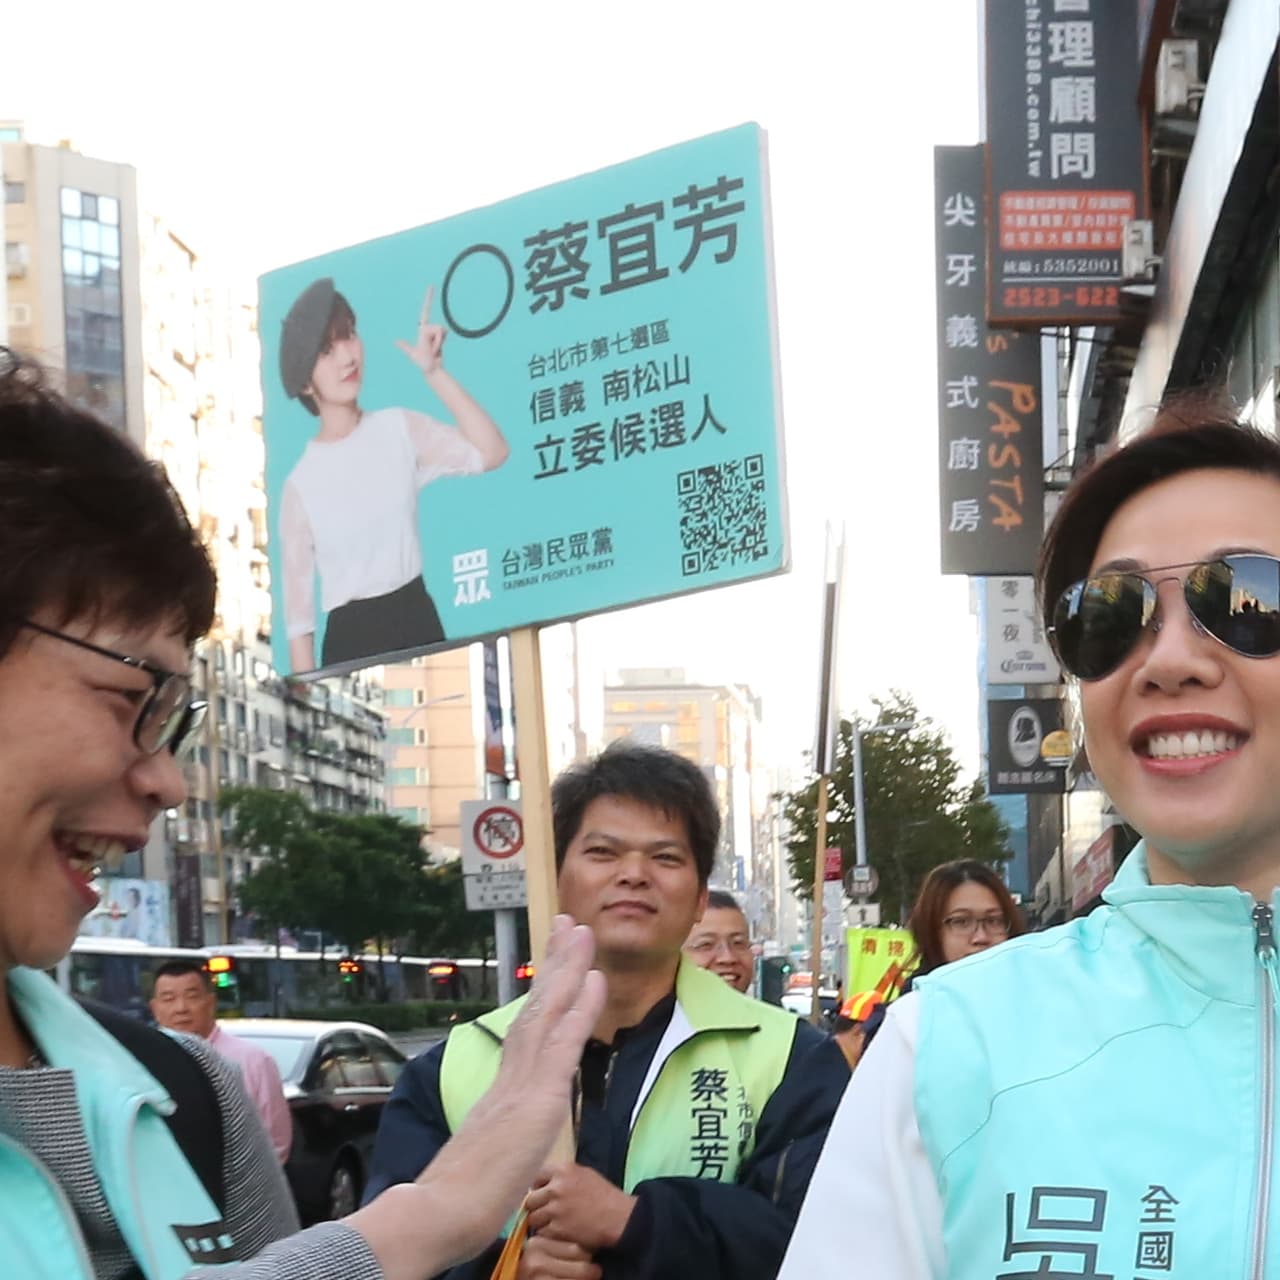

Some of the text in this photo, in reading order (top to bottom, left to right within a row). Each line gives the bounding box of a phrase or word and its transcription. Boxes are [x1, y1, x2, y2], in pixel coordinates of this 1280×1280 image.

[523, 176, 745, 315] 蔡宜芳
[527, 319, 670, 380] 台北市第七選區
[529, 353, 691, 424] 信義 南松山
[944, 192, 981, 533] 尖牙義式廚房
[533, 394, 727, 481] 立委候選人
[987, 380, 1037, 532] PASTA
[501, 527, 614, 578] 台灣民眾黨
[690, 1067, 729, 1180] 蔡宜芳
